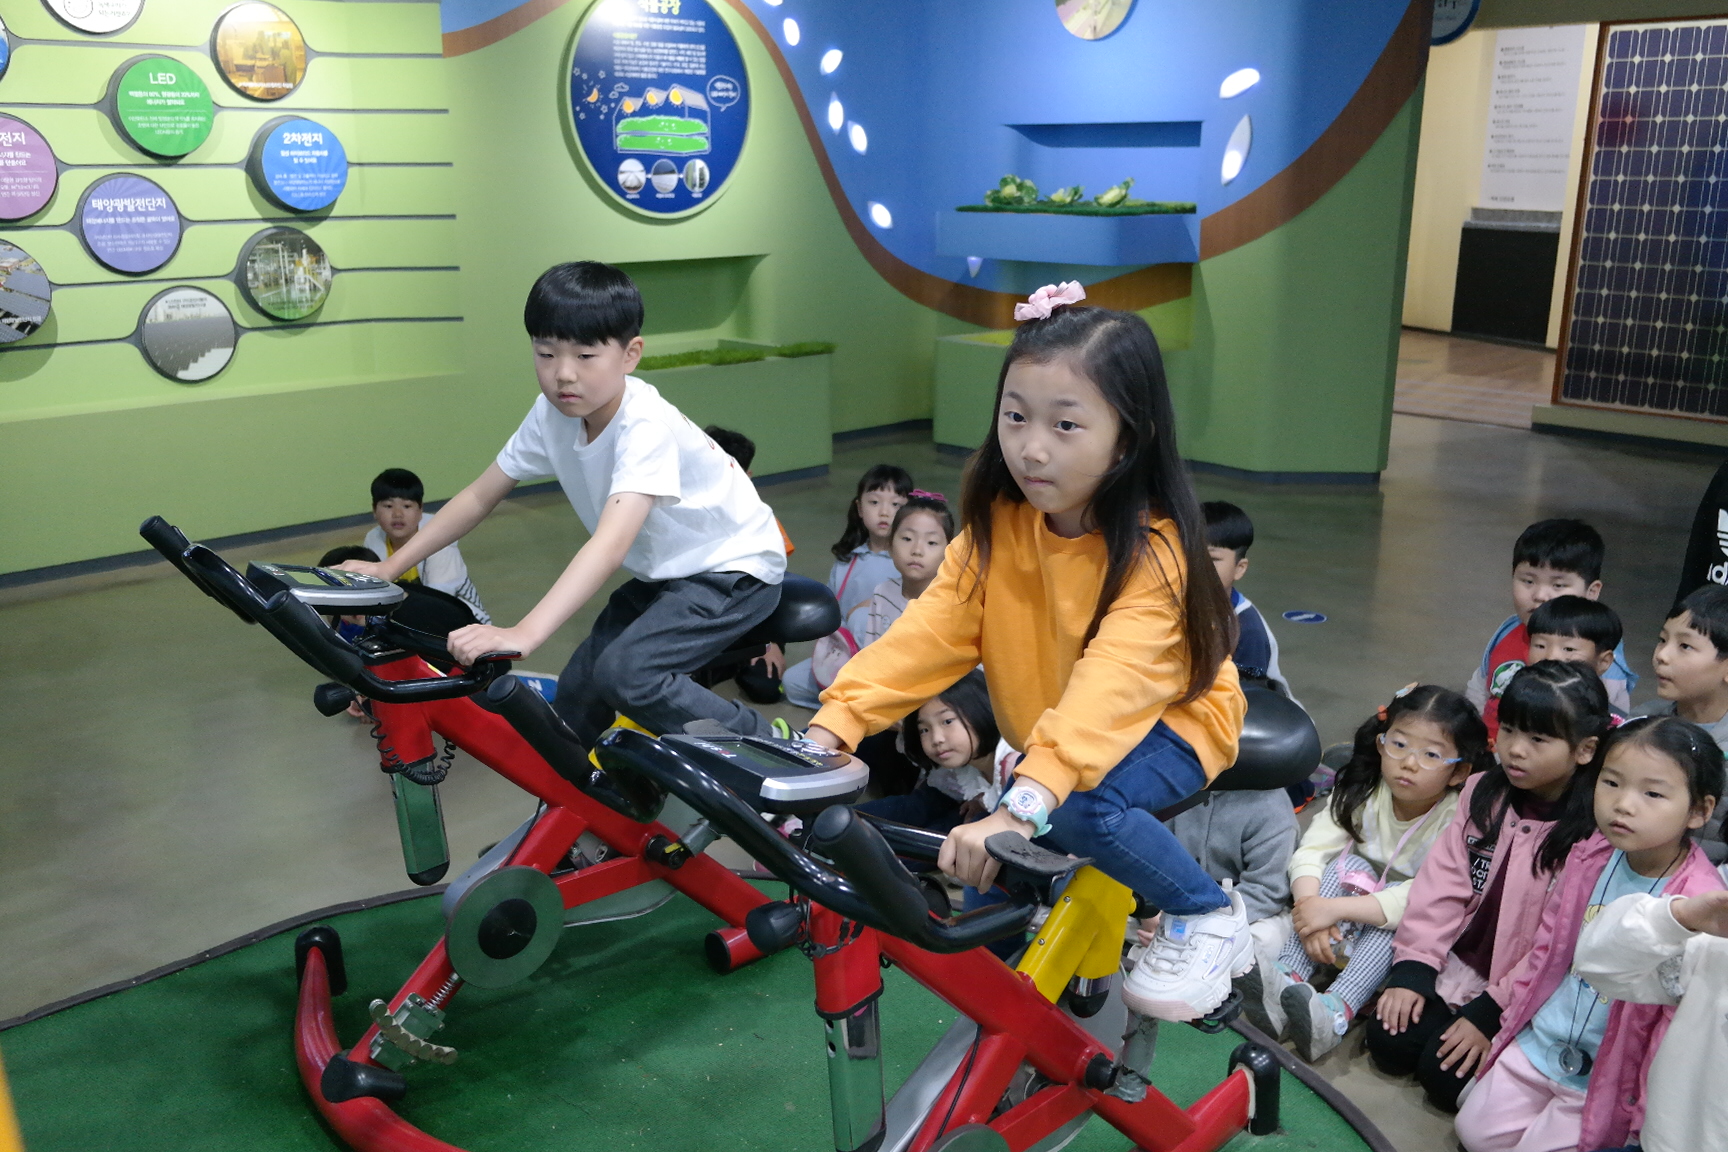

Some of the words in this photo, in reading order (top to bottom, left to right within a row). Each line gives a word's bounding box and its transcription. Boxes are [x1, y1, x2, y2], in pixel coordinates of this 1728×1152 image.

[149, 72, 176, 84] LED
[0, 131, 26, 147] 전지
[283, 132, 323, 147] 2차전지
[91, 197, 166, 212] 태양광발전단지
